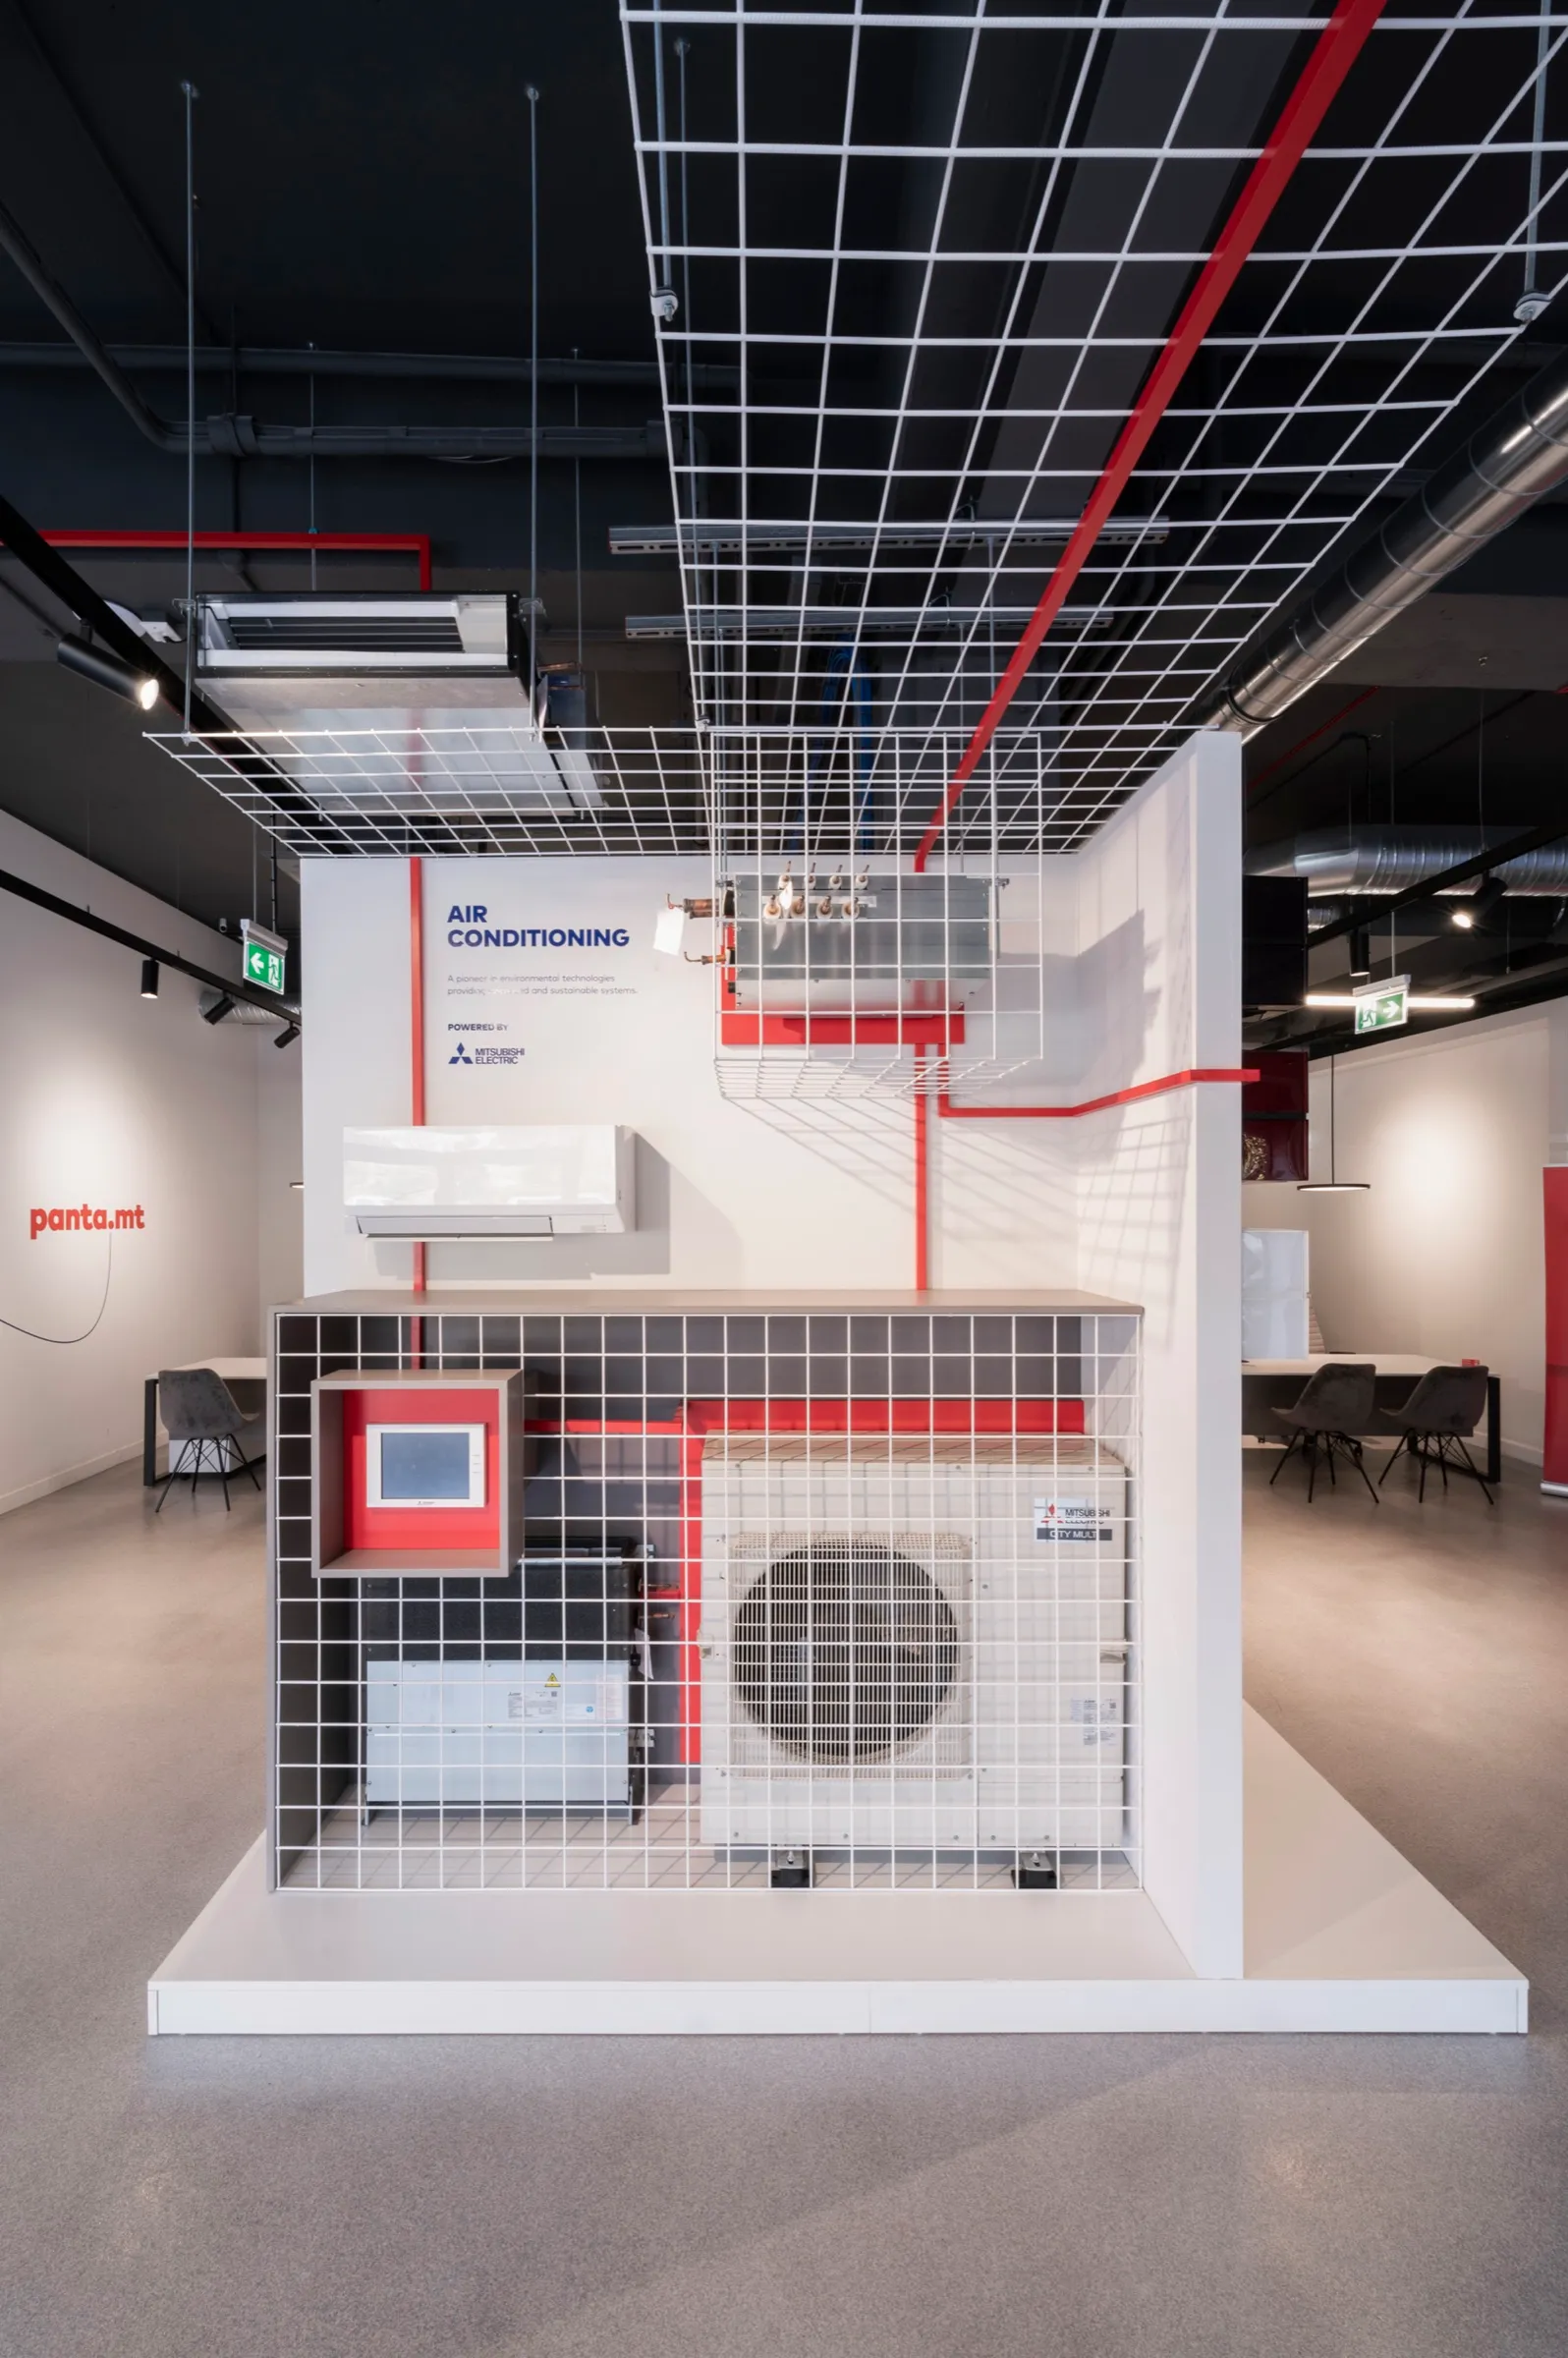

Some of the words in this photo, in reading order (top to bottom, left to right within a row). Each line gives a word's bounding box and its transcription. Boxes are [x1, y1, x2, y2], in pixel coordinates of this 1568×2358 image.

[447, 905, 487, 924] AIR
[447, 928, 630, 947] CONDITIONING
[562, 974, 615, 984] technologies
[532, 986, 548, 995] and
[550, 985, 598, 995] sustainable
[600, 986, 638, 996] systems.
[475, 1047, 526, 1056] MITSUBISHI
[475, 1056, 519, 1065] ELECTRIC
[29, 1204, 145, 1240] panta.mt
[1065, 1508, 1111, 1517] MITSUBSHI
[1049, 1530, 1072, 1539] CTY
[1073, 1530, 1099, 1539] MULT
